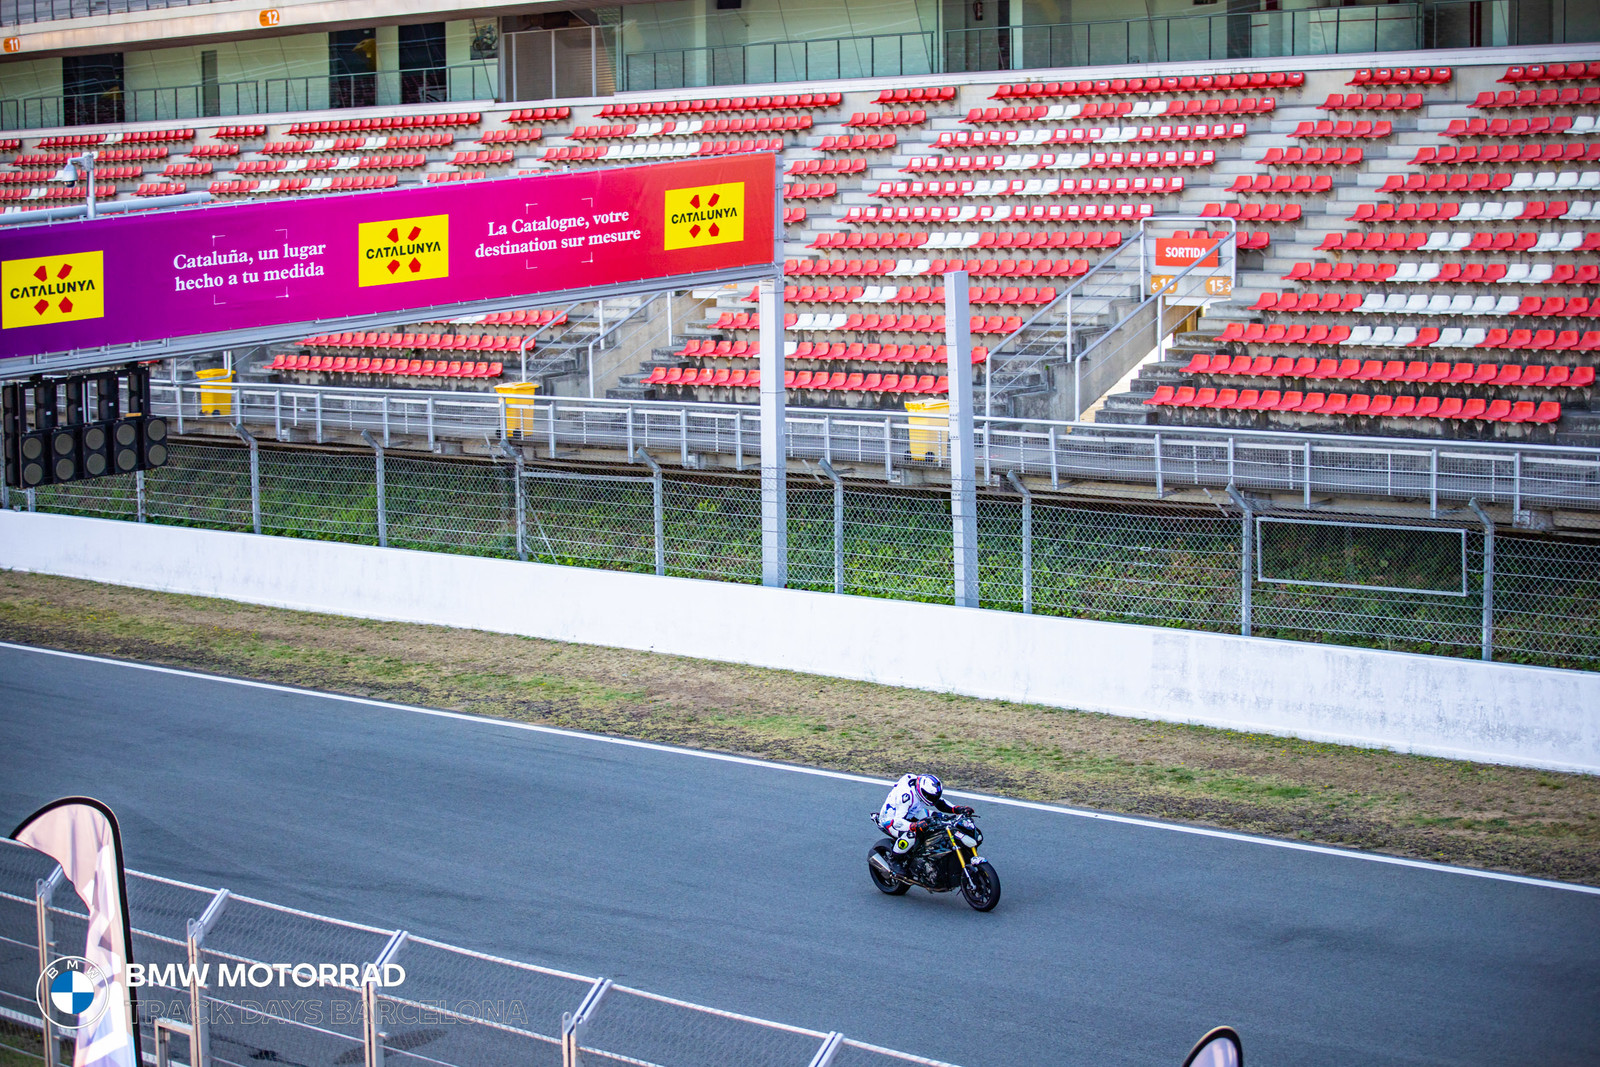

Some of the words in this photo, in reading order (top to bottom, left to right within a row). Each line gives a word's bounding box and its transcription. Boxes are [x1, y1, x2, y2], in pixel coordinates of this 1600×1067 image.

[267, 11, 278, 24] 12
[9, 39, 18, 51] 11
[488, 222, 507, 236] La
[512, 211, 590, 233] Catalogne,
[593, 211, 629, 225] votre
[671, 207, 737, 224] CATALUNYA
[366, 241, 441, 259] CATALUNYA
[475, 237, 557, 258] destination
[561, 235, 585, 248] sur
[588, 229, 641, 246] mesure
[1165, 247, 1207, 258] SORTIDA
[173, 250, 254, 270] Cataluña,
[258, 248, 279, 261] un
[283, 243, 327, 260] lugar
[174, 273, 224, 292] hecho
[228, 274, 238, 285] a
[242, 271, 259, 283] tu
[263, 262, 325, 282] medida
[1209, 279, 1224, 292] 15
[10, 279, 95, 299] CATALUNYA
